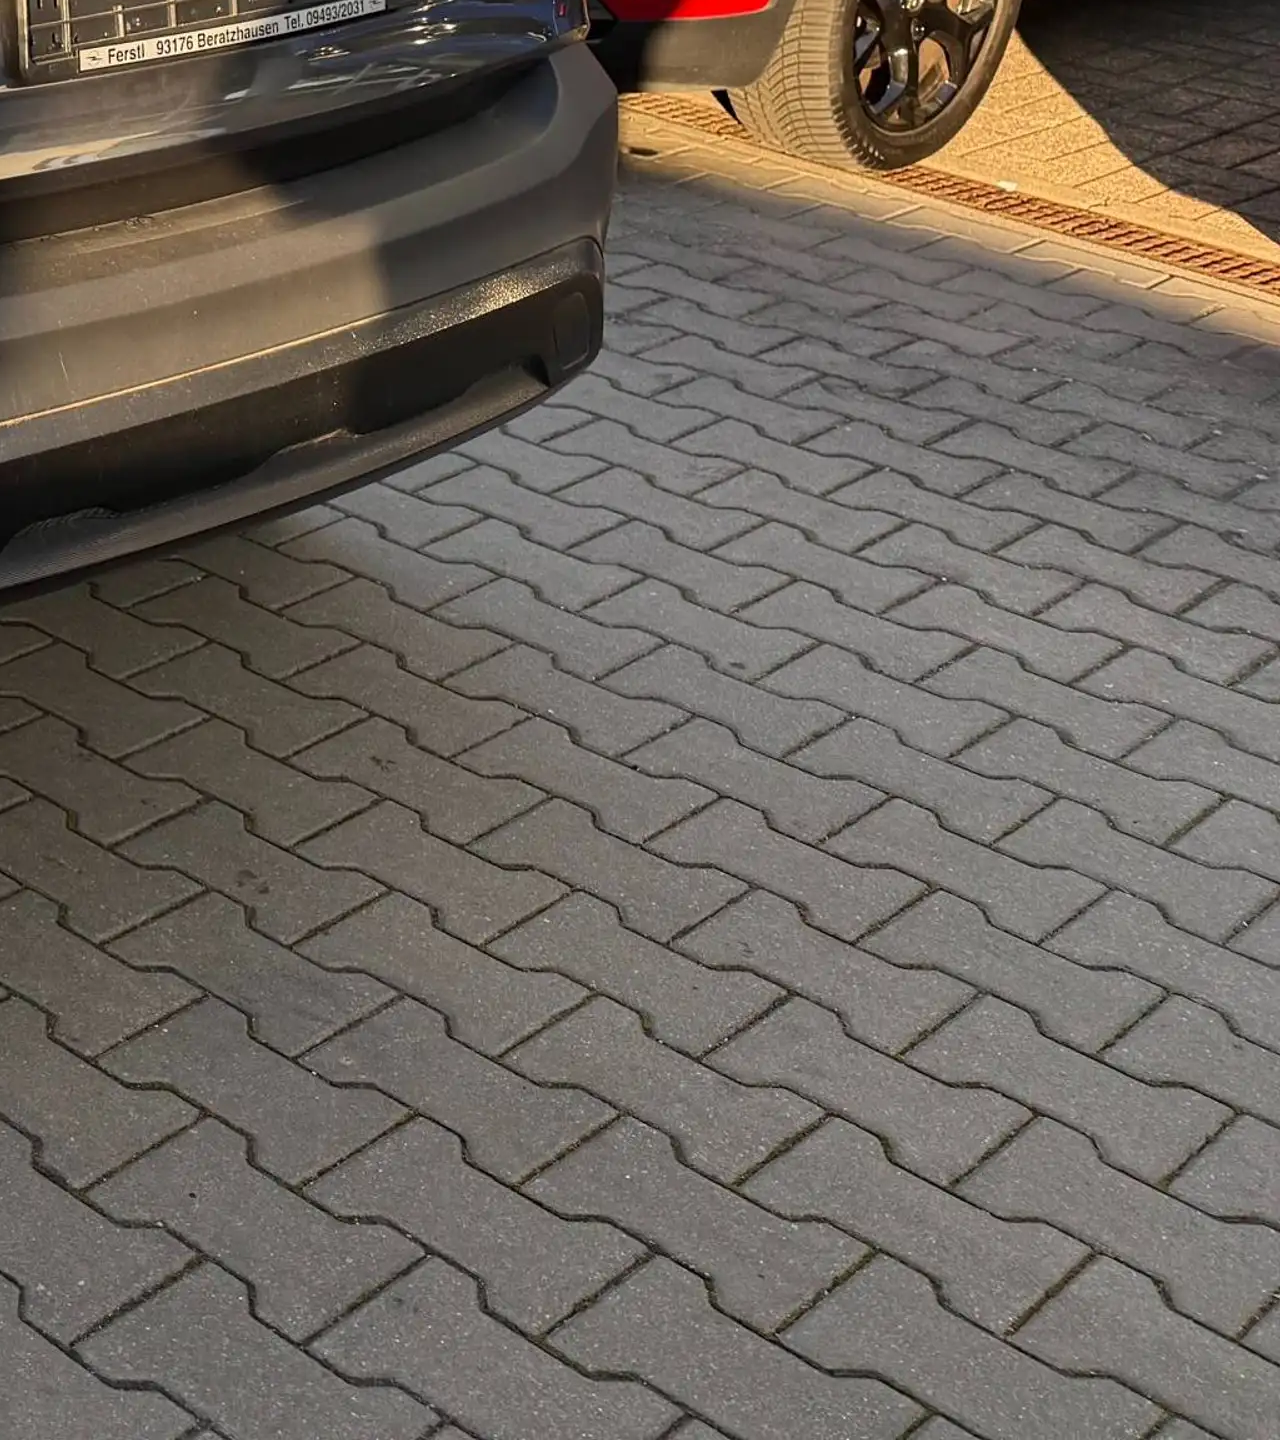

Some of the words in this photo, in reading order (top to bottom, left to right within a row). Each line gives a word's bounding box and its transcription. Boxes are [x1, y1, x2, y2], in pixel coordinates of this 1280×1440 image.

[107, 45, 146, 65] Ferstl
[155, 38, 194, 57] 93176
[197, 22, 279, 48] Beratzhausen
[284, 15, 304, 31] Tel.
[306, 0, 365, 26] 09493/2031
